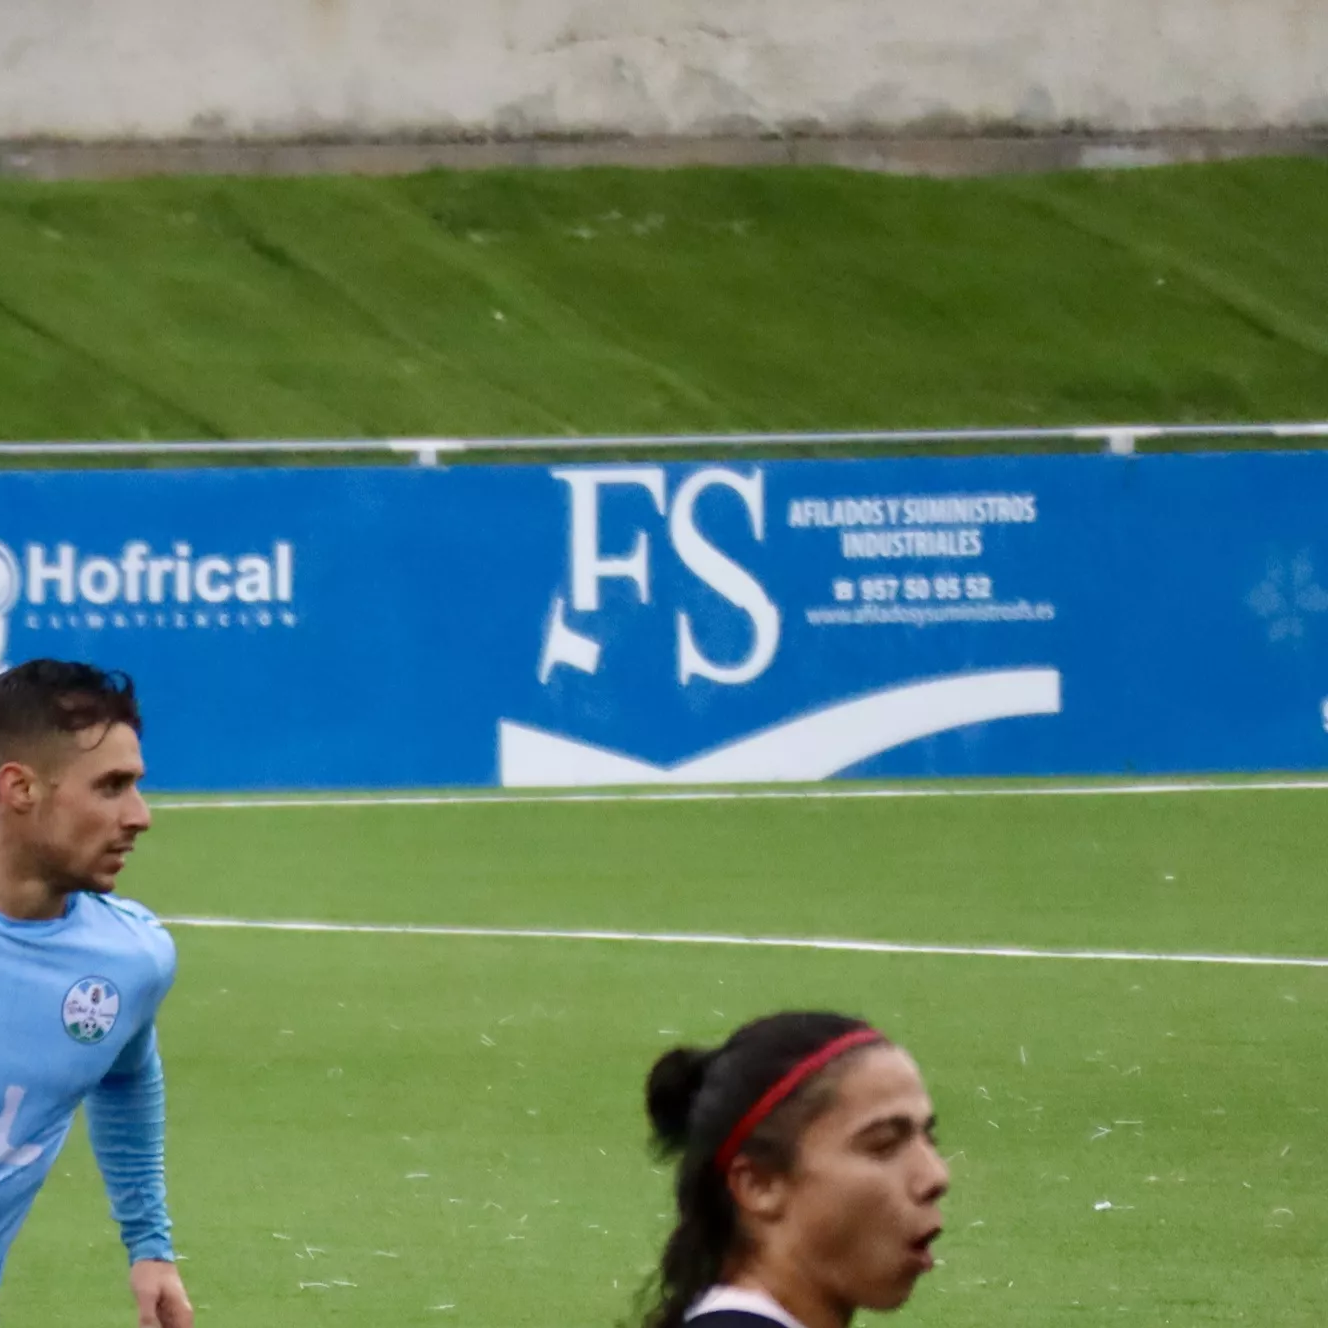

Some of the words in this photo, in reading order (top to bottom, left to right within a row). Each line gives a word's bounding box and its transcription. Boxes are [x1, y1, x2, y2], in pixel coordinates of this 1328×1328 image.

[788, 497, 884, 527] AFILADOS
[885, 498, 902, 525] Y
[902, 493, 1038, 524] SUMINISTROS
[841, 528, 983, 558] INDUSTRIALES
[26, 542, 293, 605] Hofrical
[539, 464, 782, 686] FS
[859, 575, 899, 602] 957
[902, 575, 931, 601] 50
[934, 575, 961, 601] 95
[964, 573, 992, 600] 52
